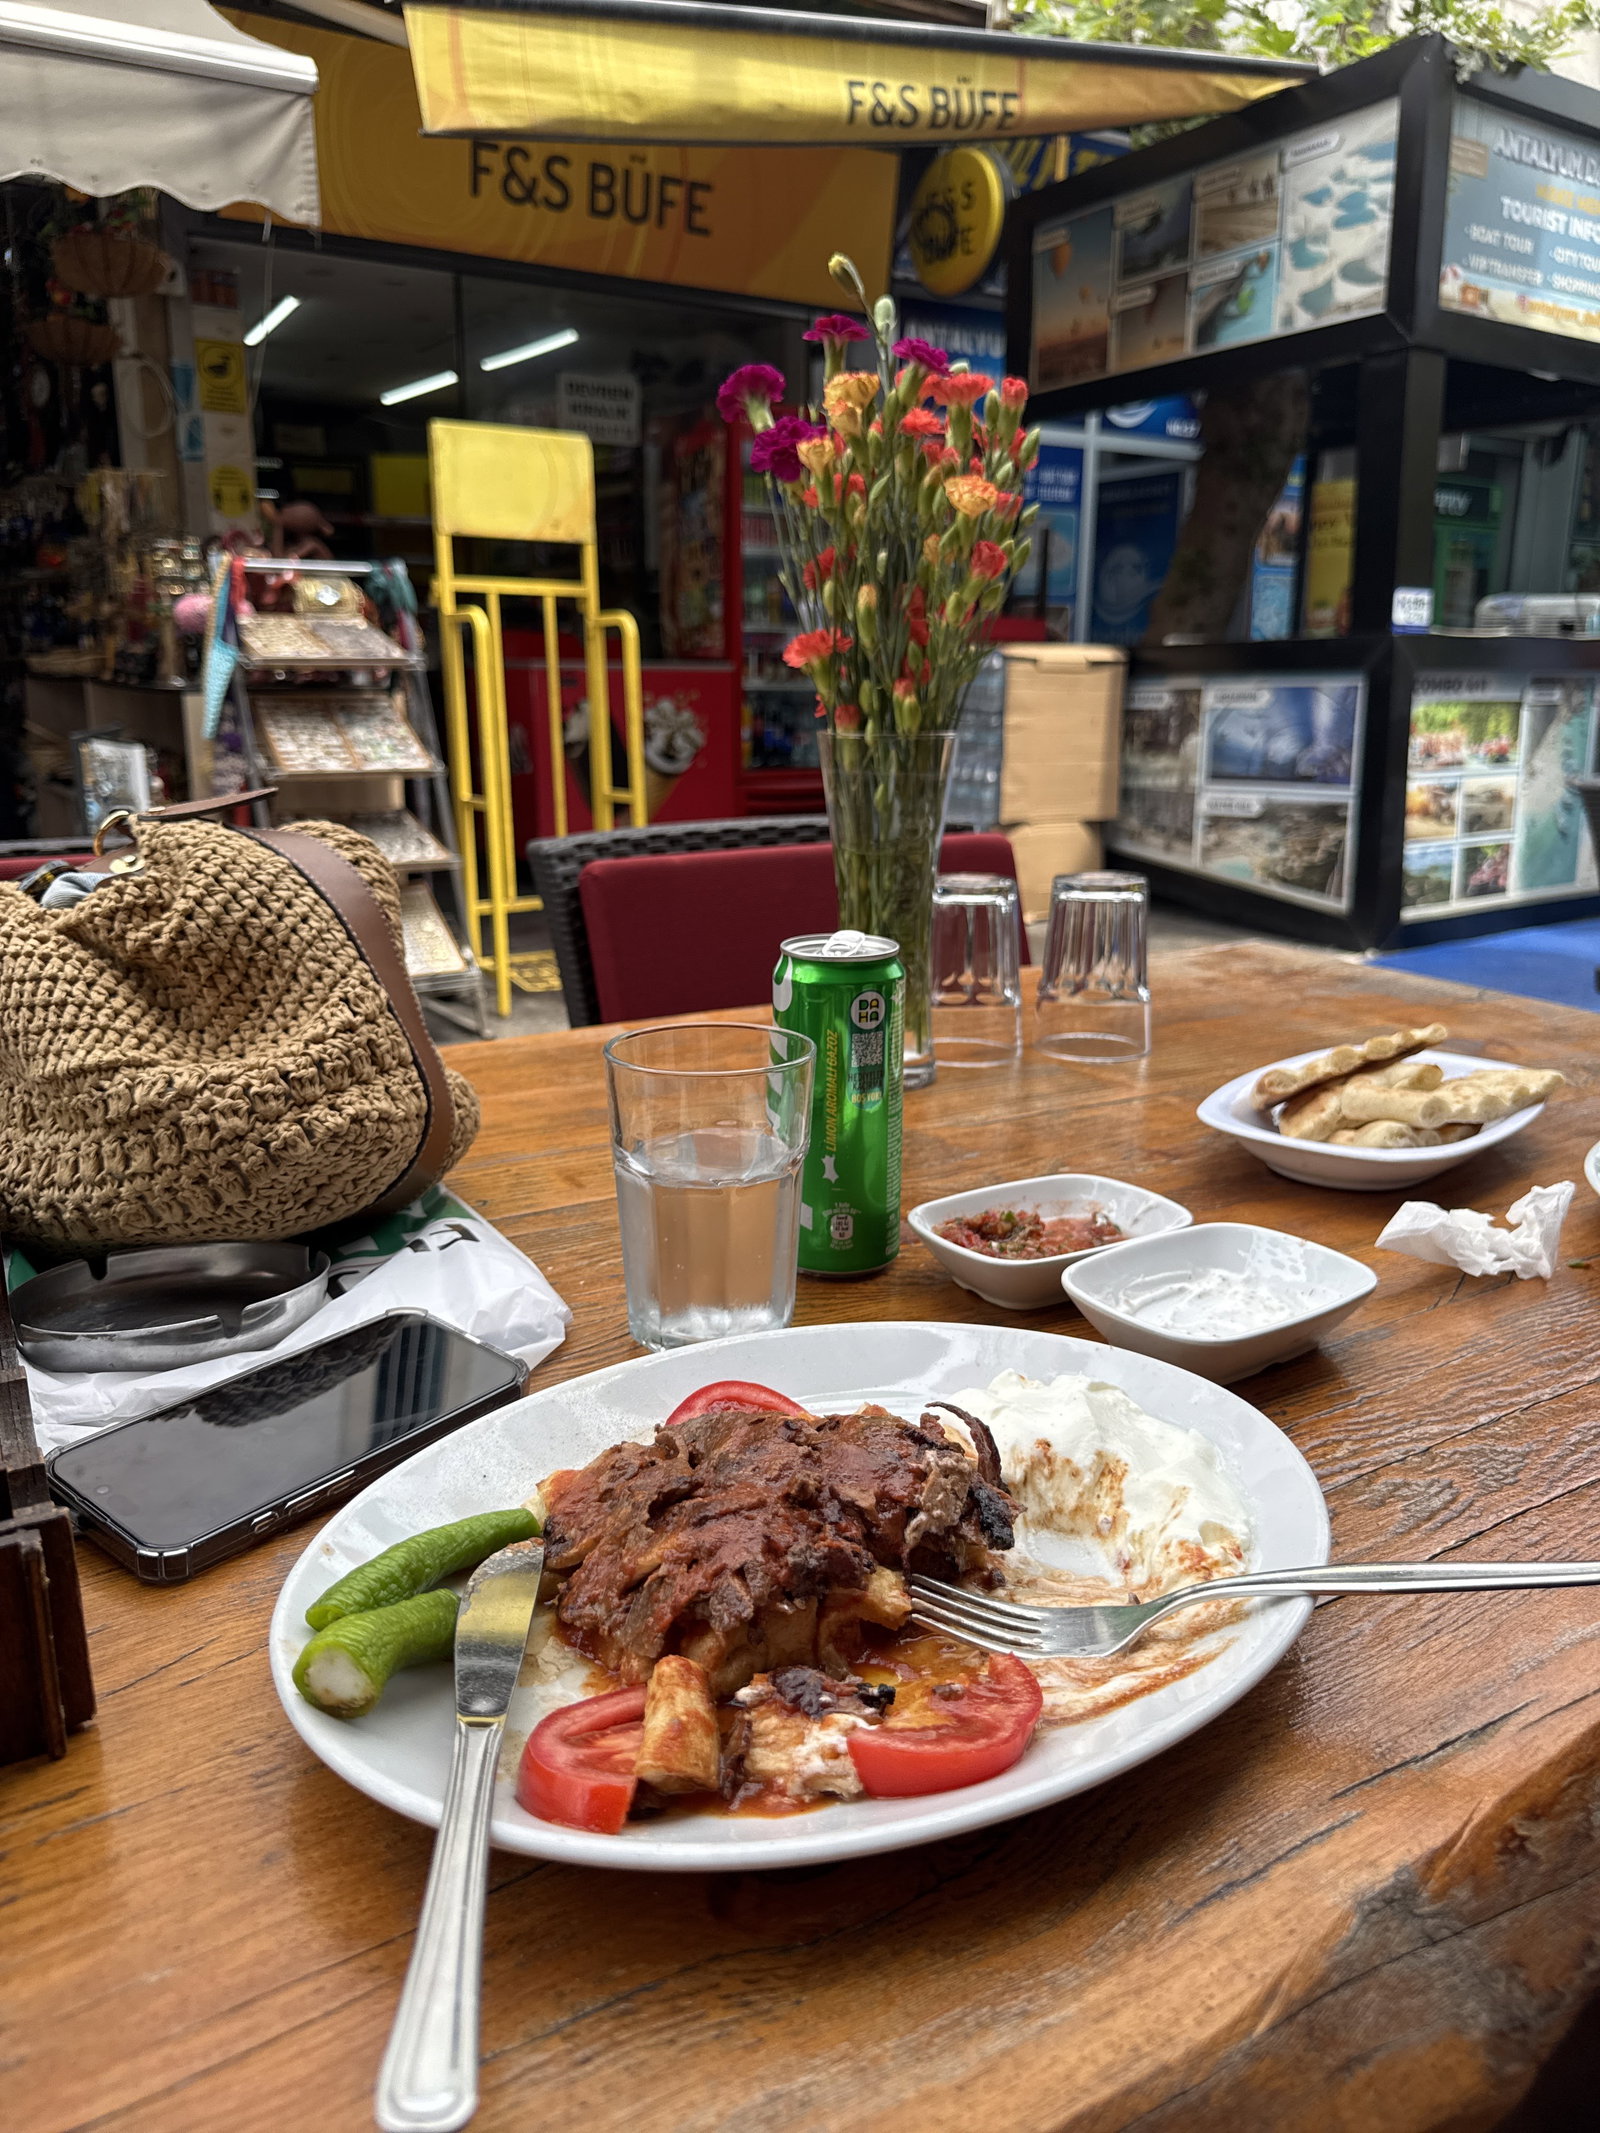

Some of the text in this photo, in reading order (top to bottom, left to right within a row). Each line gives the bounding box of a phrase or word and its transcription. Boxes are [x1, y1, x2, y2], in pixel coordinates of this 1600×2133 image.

[847, 75, 1019, 130] F&S BÜFE
[469, 139, 713, 237] F&S BÜFE
[1500, 196, 1568, 235] TOURIST
[1469, 223, 1534, 256] BOAT TOUR
[858, 998, 880, 1011] DA
[858, 1010, 880, 1022] HA
[824, 1028, 838, 1153] LİMON AROMALI GAZOZ
